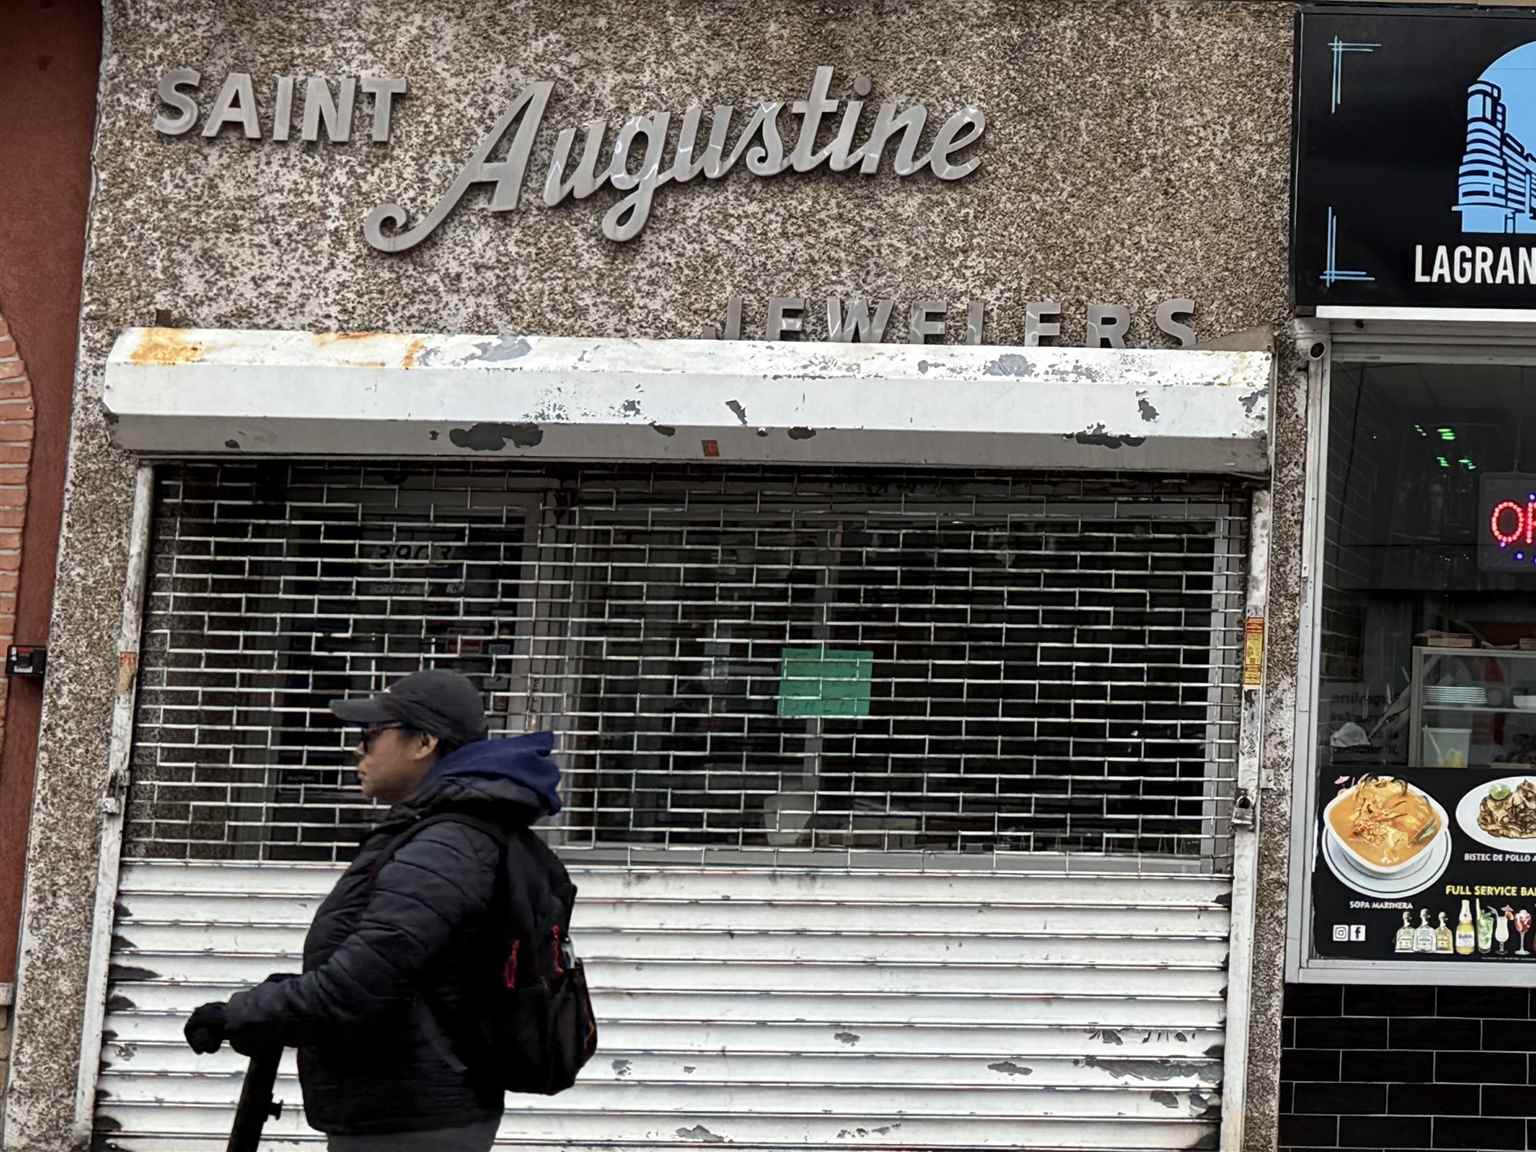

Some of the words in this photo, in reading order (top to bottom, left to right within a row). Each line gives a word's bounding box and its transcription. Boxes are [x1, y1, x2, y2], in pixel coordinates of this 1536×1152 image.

[153, 68, 407, 145] SAINT
[364, 64, 987, 253] Augustine
[1464, 853, 1492, 862] BISTEC
[1493, 854, 1503, 862] DE
[1505, 854, 1531, 863] POLLO
[1445, 885, 1472, 896] FULL
[1474, 885, 1518, 897] SERVICE
[1349, 901, 1371, 909] SOPA
[1372, 901, 1414, 910] MARINERA
